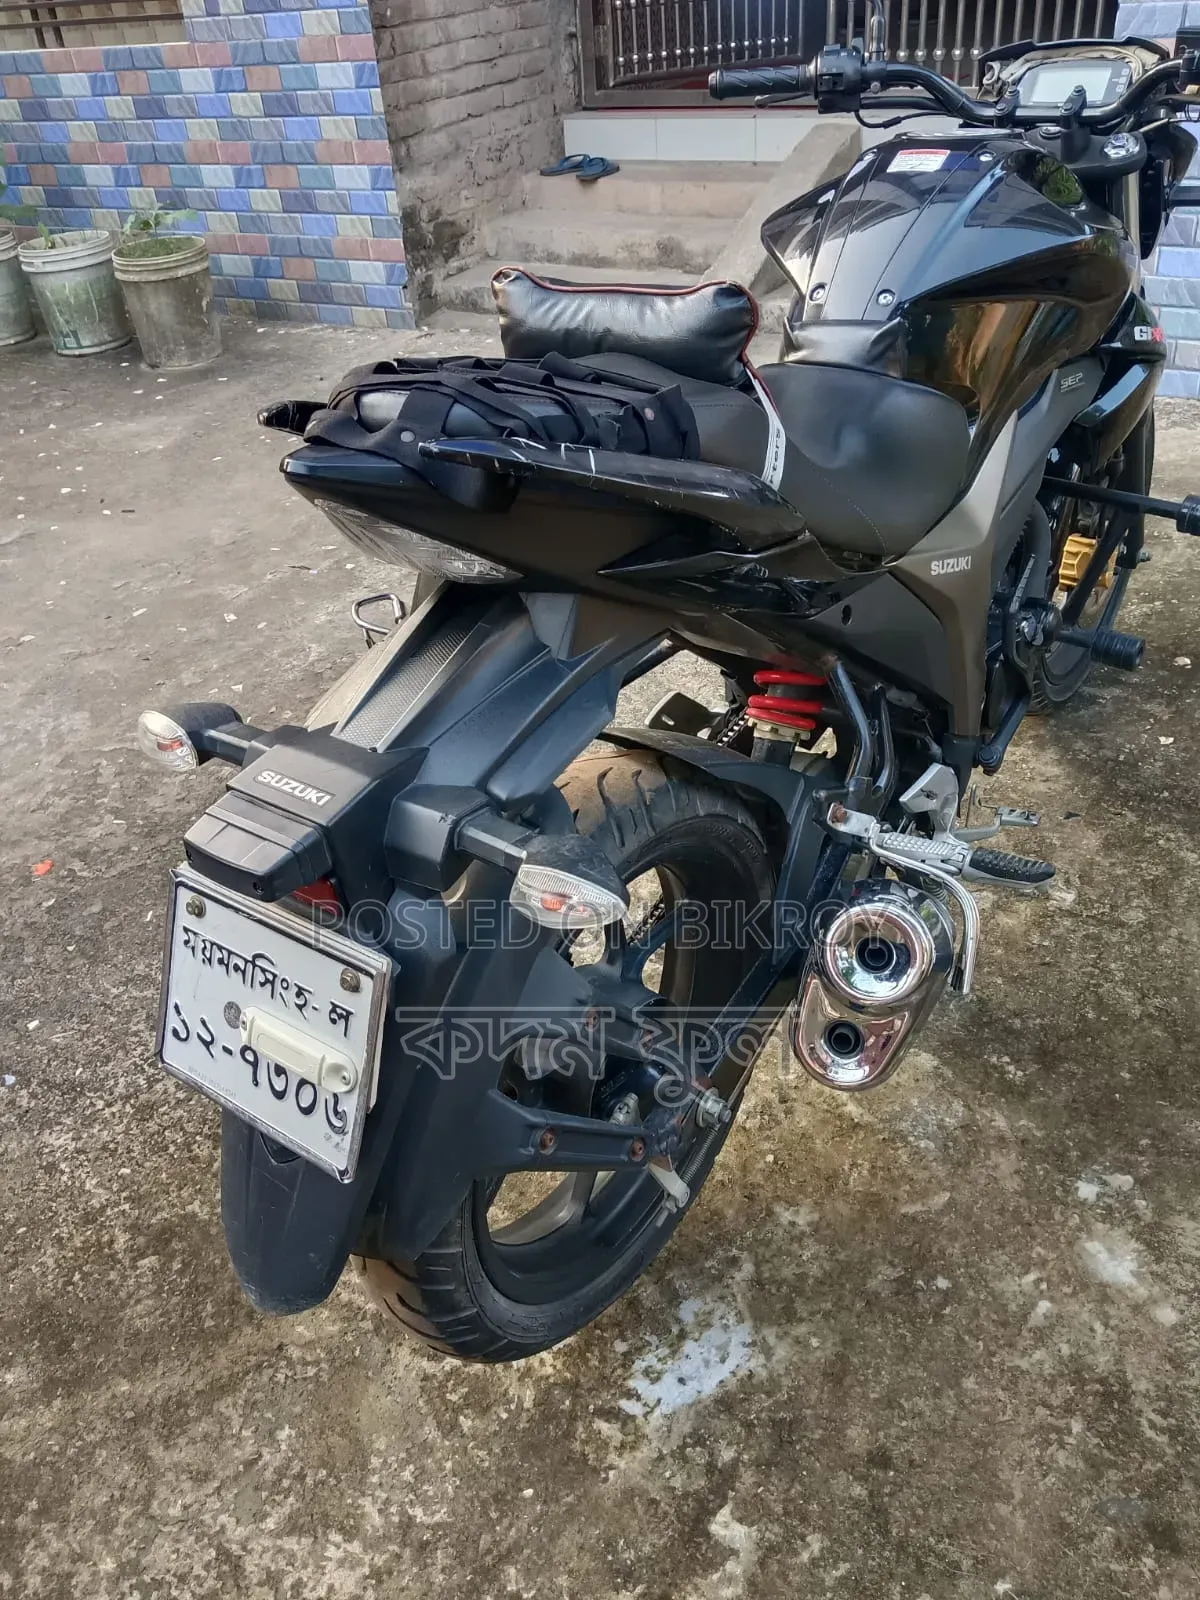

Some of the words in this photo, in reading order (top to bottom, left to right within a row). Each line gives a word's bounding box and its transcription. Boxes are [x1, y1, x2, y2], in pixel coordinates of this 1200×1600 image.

[1060, 371, 1083, 389] SEP
[930, 555, 971, 576] SUZUKI
[257, 769, 332, 806] SUZUKI
